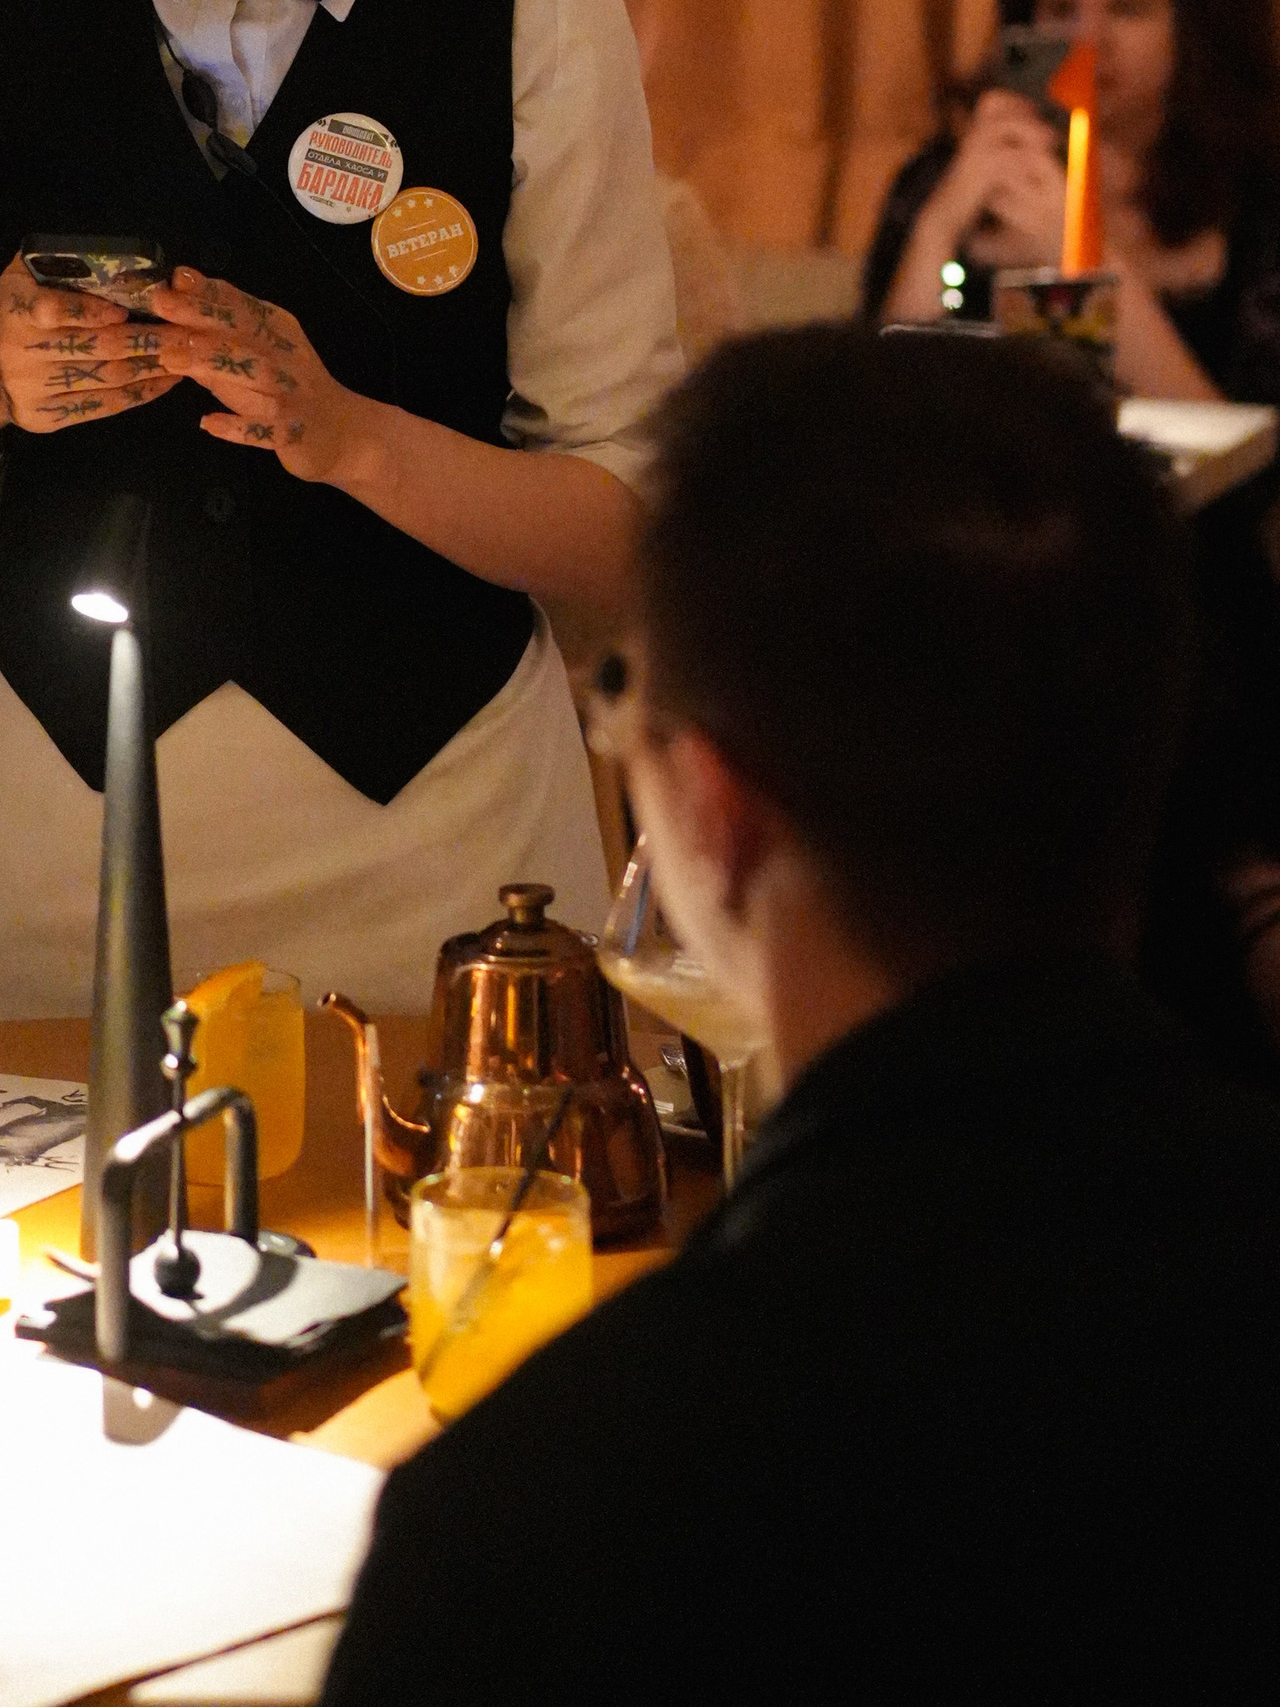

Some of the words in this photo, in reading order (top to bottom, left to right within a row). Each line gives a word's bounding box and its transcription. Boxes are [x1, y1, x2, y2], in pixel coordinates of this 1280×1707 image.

[307, 152, 341, 168] ОТДЕЛА
[345, 160, 375, 177] ХАОСА
[377, 169, 386, 179] И
[308, 130, 393, 169] РУКОВОДИТЕЛЬ
[297, 162, 384, 211] БАРДАКА
[386, 222, 465, 259] ВЕТЕРАН
